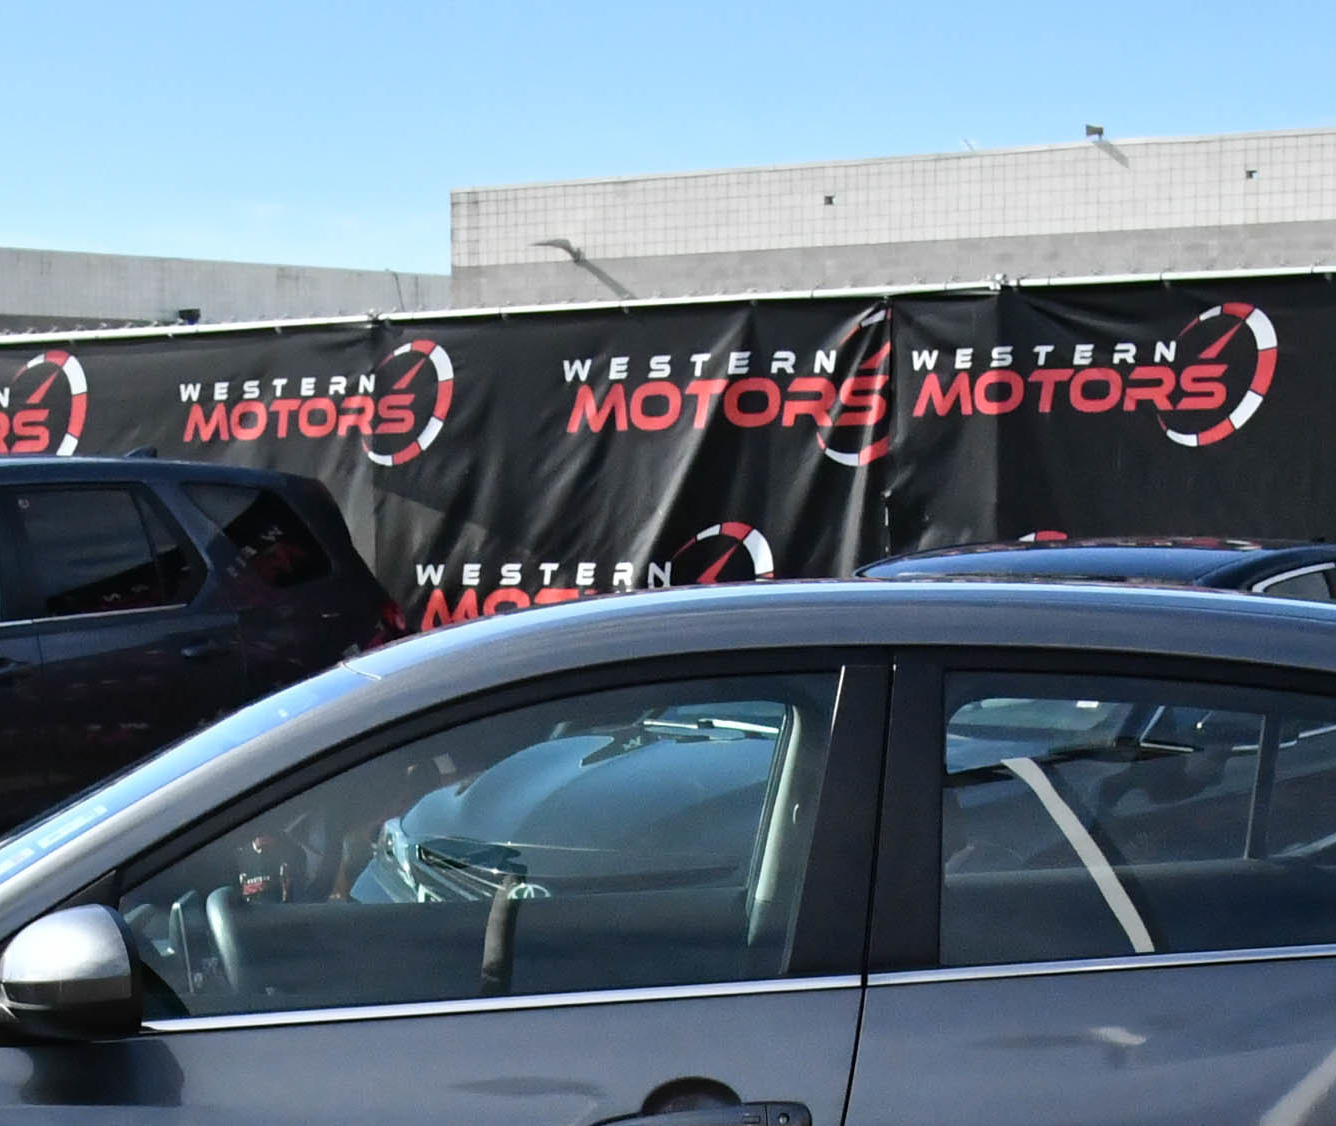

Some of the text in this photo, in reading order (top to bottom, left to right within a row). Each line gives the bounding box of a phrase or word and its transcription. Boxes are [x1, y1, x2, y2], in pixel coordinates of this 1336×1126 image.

[563, 349, 837, 382] WESTERN
[912, 341, 1177, 371] WESTERN
[179, 374, 376, 402] WESTERN
[566, 374, 889, 433] MOTORS
[913, 363, 1228, 417] MOTORS
[183, 393, 416, 442] MOTORS
[416, 562, 672, 588] WESTERN
